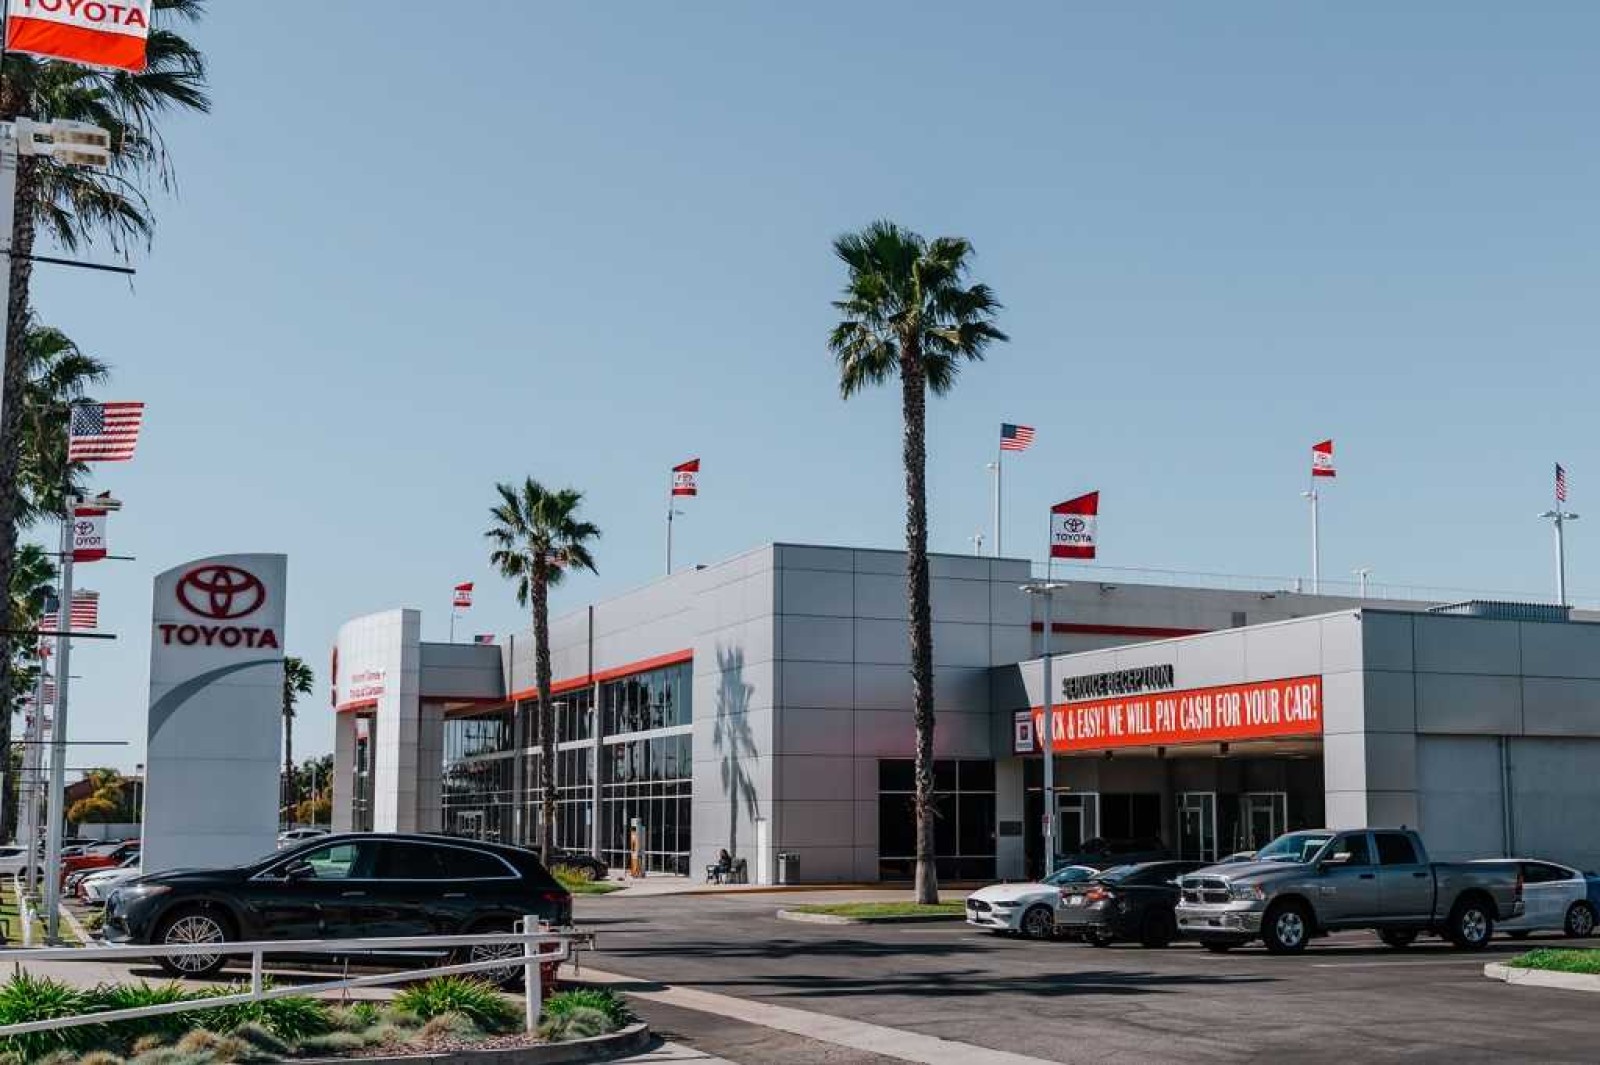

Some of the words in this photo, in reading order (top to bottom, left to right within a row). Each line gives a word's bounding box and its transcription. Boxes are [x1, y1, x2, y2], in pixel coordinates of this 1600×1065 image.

[76, 536, 101, 546] OYOT
[1056, 533, 1092, 542] TOYOTA
[159, 624, 279, 649] TOYOTA
[1062, 674, 1108, 699] SERVICE
[1107, 664, 1174, 695] RECEPTION
[1035, 711, 1065, 748] QCK
[1067, 709, 1075, 740] &
[1078, 706, 1105, 738] EASY!
[1107, 704, 1124, 736] WE
[1126, 701, 1153, 735] WILL
[1156, 699, 1177, 733] PAY
[1216, 692, 1241, 727] FOR
[1243, 687, 1280, 726] YOUR
[1284, 682, 1317, 722] CAR!
